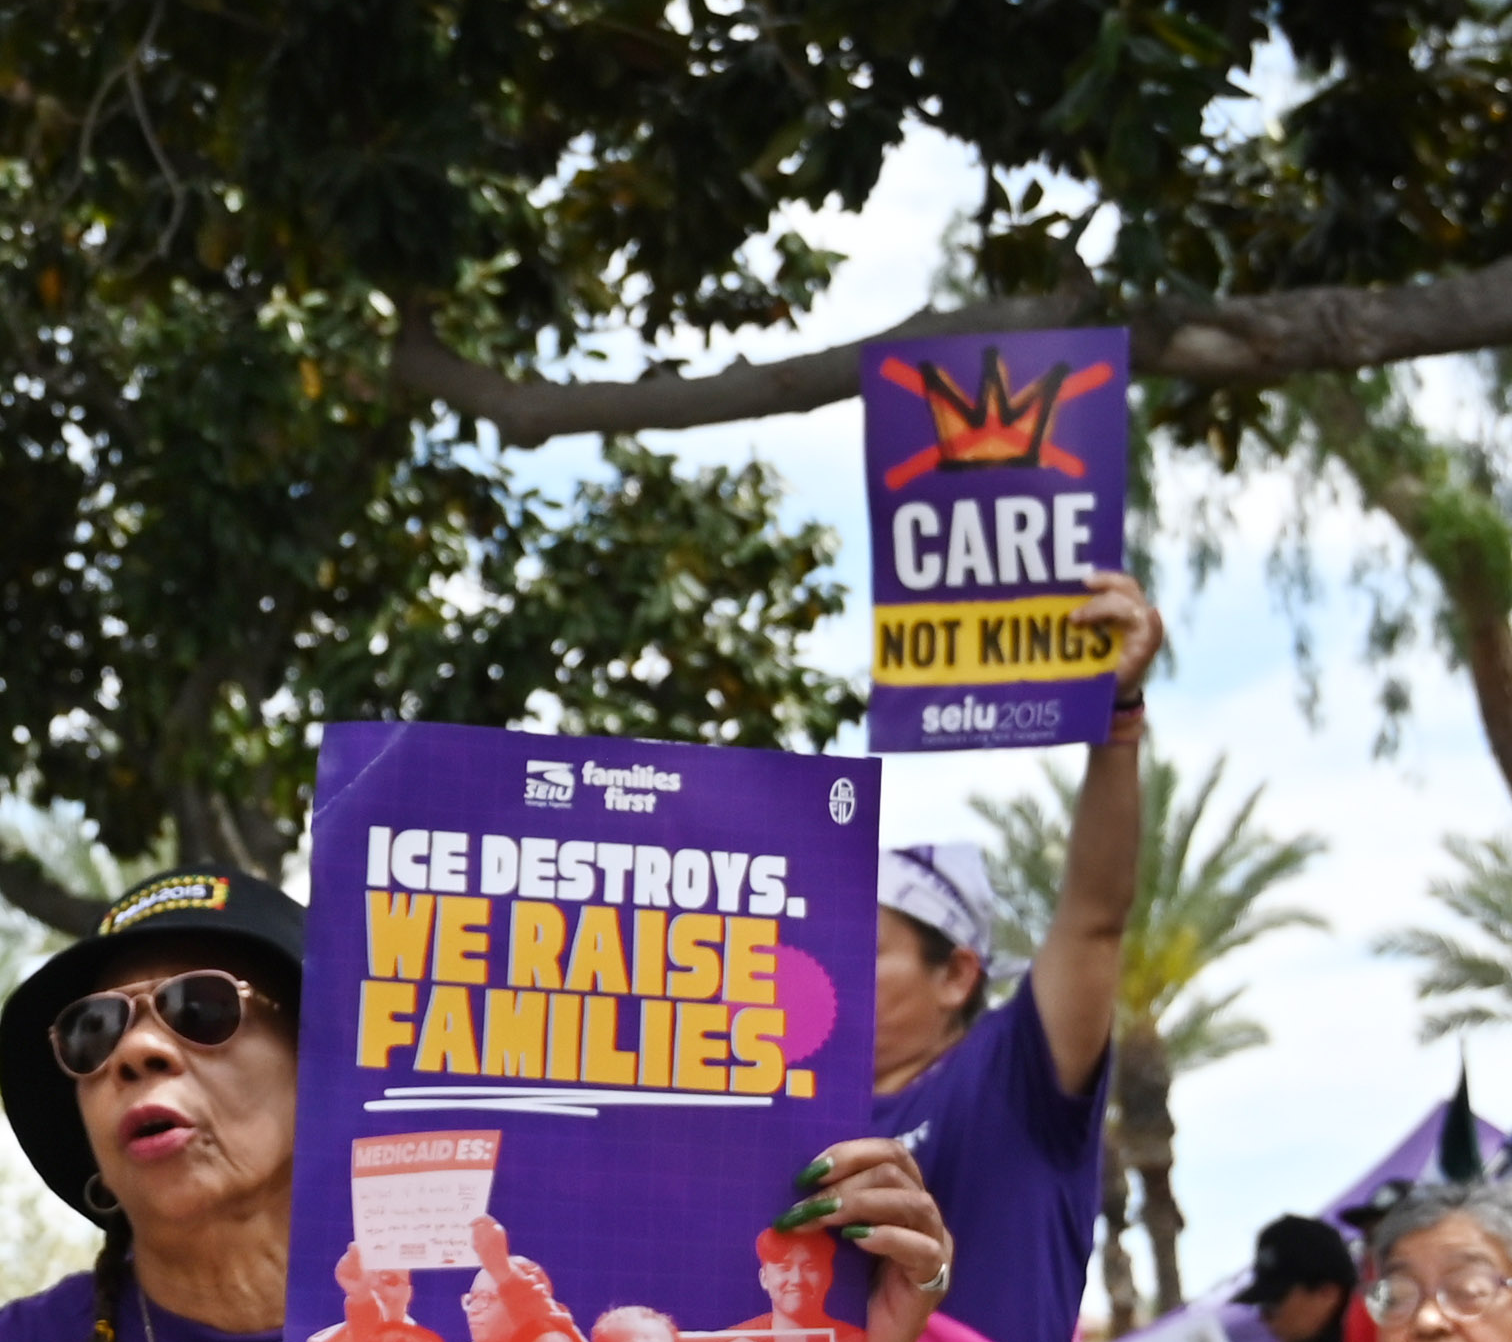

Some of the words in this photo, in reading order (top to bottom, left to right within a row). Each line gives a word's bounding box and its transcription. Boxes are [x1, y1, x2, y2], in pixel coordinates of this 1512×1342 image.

[892, 492, 1097, 591] CARE
[880, 619, 961, 669] NOT
[979, 616, 1113, 666] KINGS
[523, 782, 574, 802] SEIU
[582, 760, 681, 791] families
[604, 785, 657, 813] first
[366, 825, 470, 893] ICE
[479, 833, 807, 919] DESTROYS.
[365, 889, 491, 985] WE
[507, 899, 779, 1005] RAISE
[356, 979, 816, 1098] FAMILIES.
[354, 1139, 456, 1169] MEDICAID
